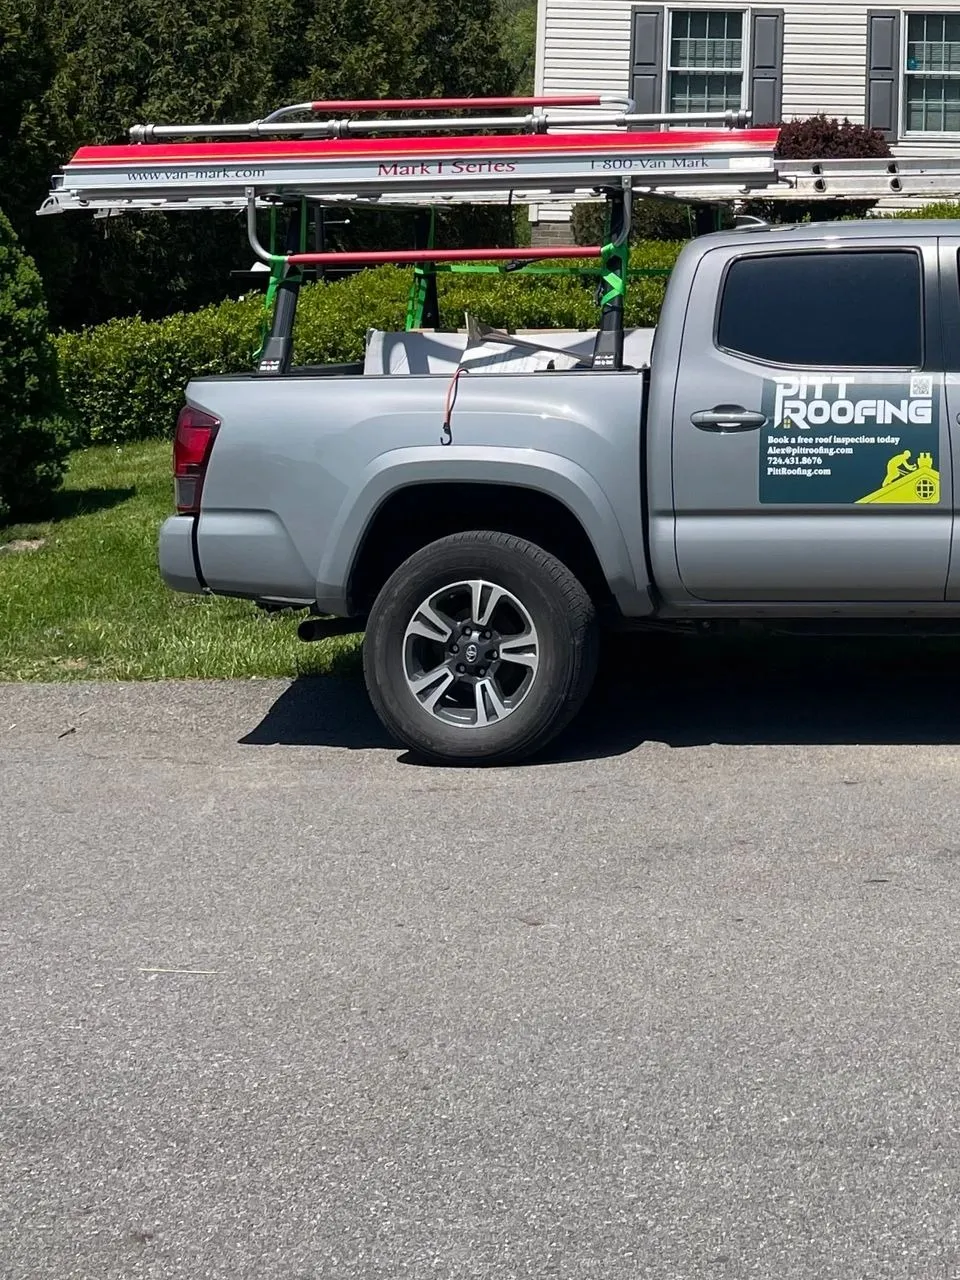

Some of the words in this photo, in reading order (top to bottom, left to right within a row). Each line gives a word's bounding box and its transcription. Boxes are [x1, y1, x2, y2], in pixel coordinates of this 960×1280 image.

[378, 162, 429, 177] Mark
[451, 160, 517, 174] Series
[590, 159, 666, 170] 1-800-Van
[671, 157, 709, 168] Mark
[127, 167, 265, 182] www.van-mark.com
[773, 376, 854, 428] PITT
[784, 400, 932, 429] ROOFING
[767, 436, 789, 444] Book
[797, 436, 814, 444] free
[815, 436, 832, 444] roof
[833, 436, 875, 445] inspection
[877, 436, 900, 445] today
[767, 446, 853, 456] Alex@pittroofing.com
[767, 457, 822, 465] 724.431.8676
[767, 467, 831, 477] PittRoofing.com
